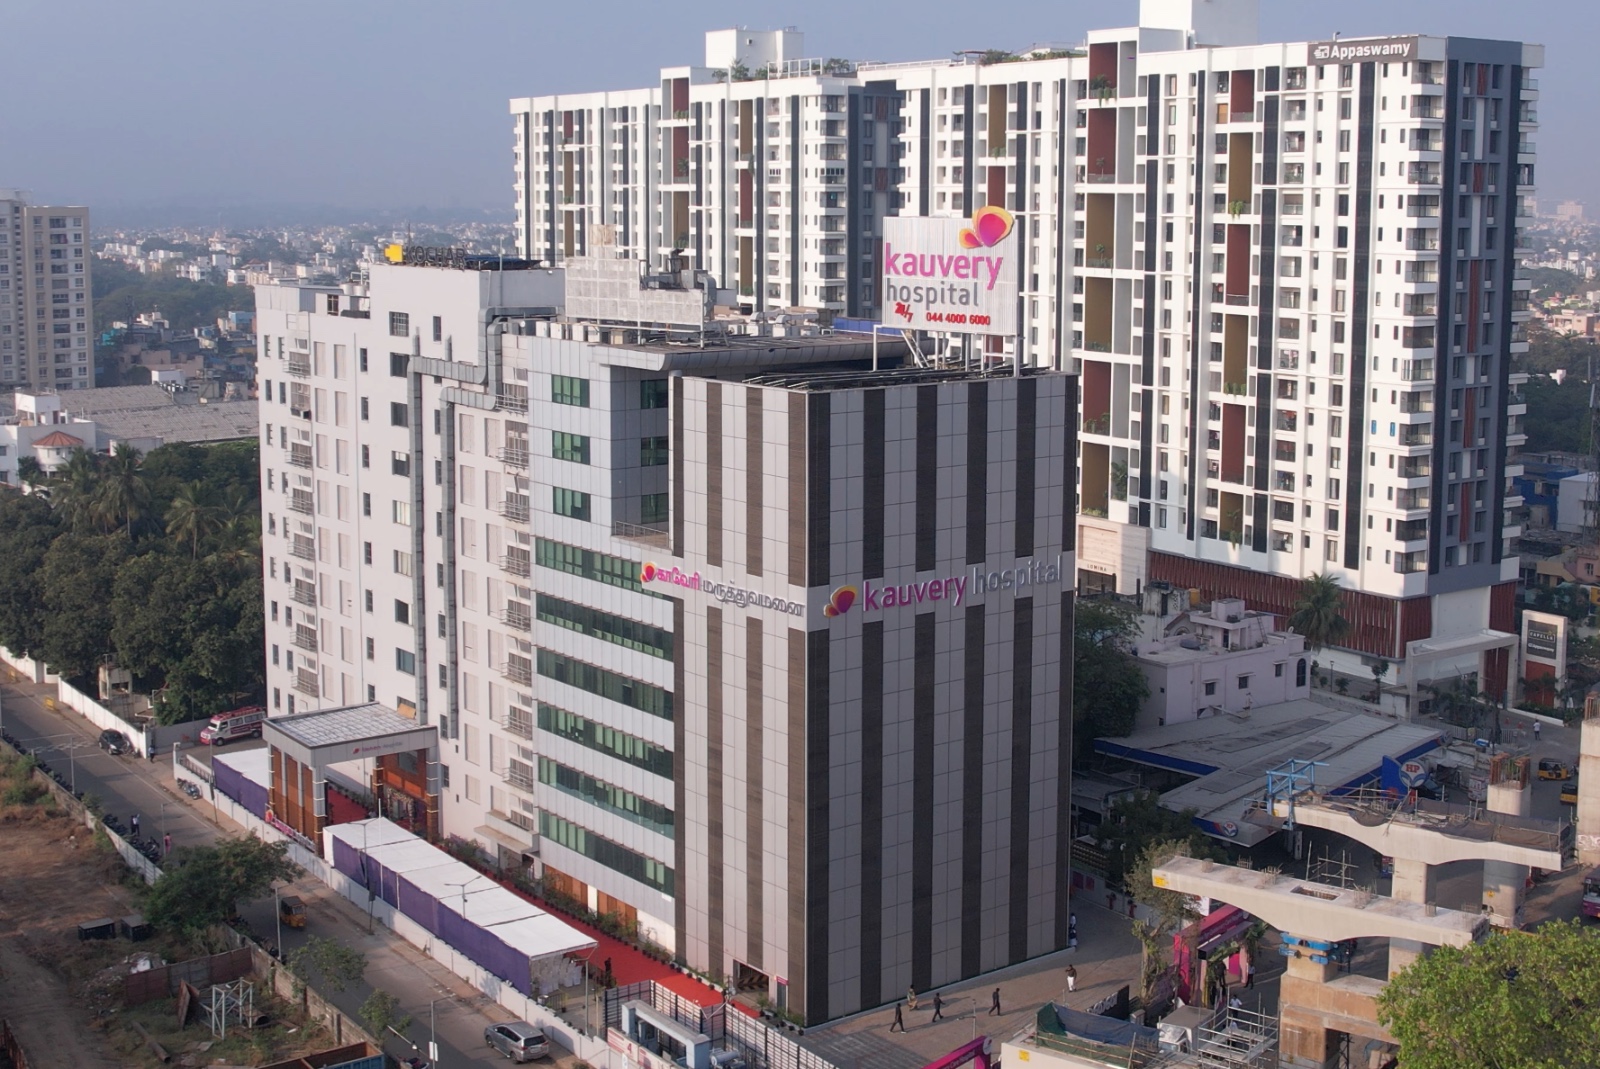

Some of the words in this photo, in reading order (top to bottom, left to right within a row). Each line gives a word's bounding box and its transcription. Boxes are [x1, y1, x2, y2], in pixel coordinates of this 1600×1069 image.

[1330, 43, 1411, 60] Appaswamy
[404, 246, 466, 266] KOCHAR
[885, 242, 1004, 290] kauvery
[886, 277, 979, 310] hospital
[926, 312, 943, 323] 044
[945, 313, 967, 325] 4000
[969, 314, 991, 326] 6000
[657, 566, 701, 591] காவேரி
[702, 580, 806, 618] மருத்துவமனை
[862, 577, 968, 611] kauvery
[973, 554, 1063, 596] hospital
[1405, 763, 1421, 773] HP
